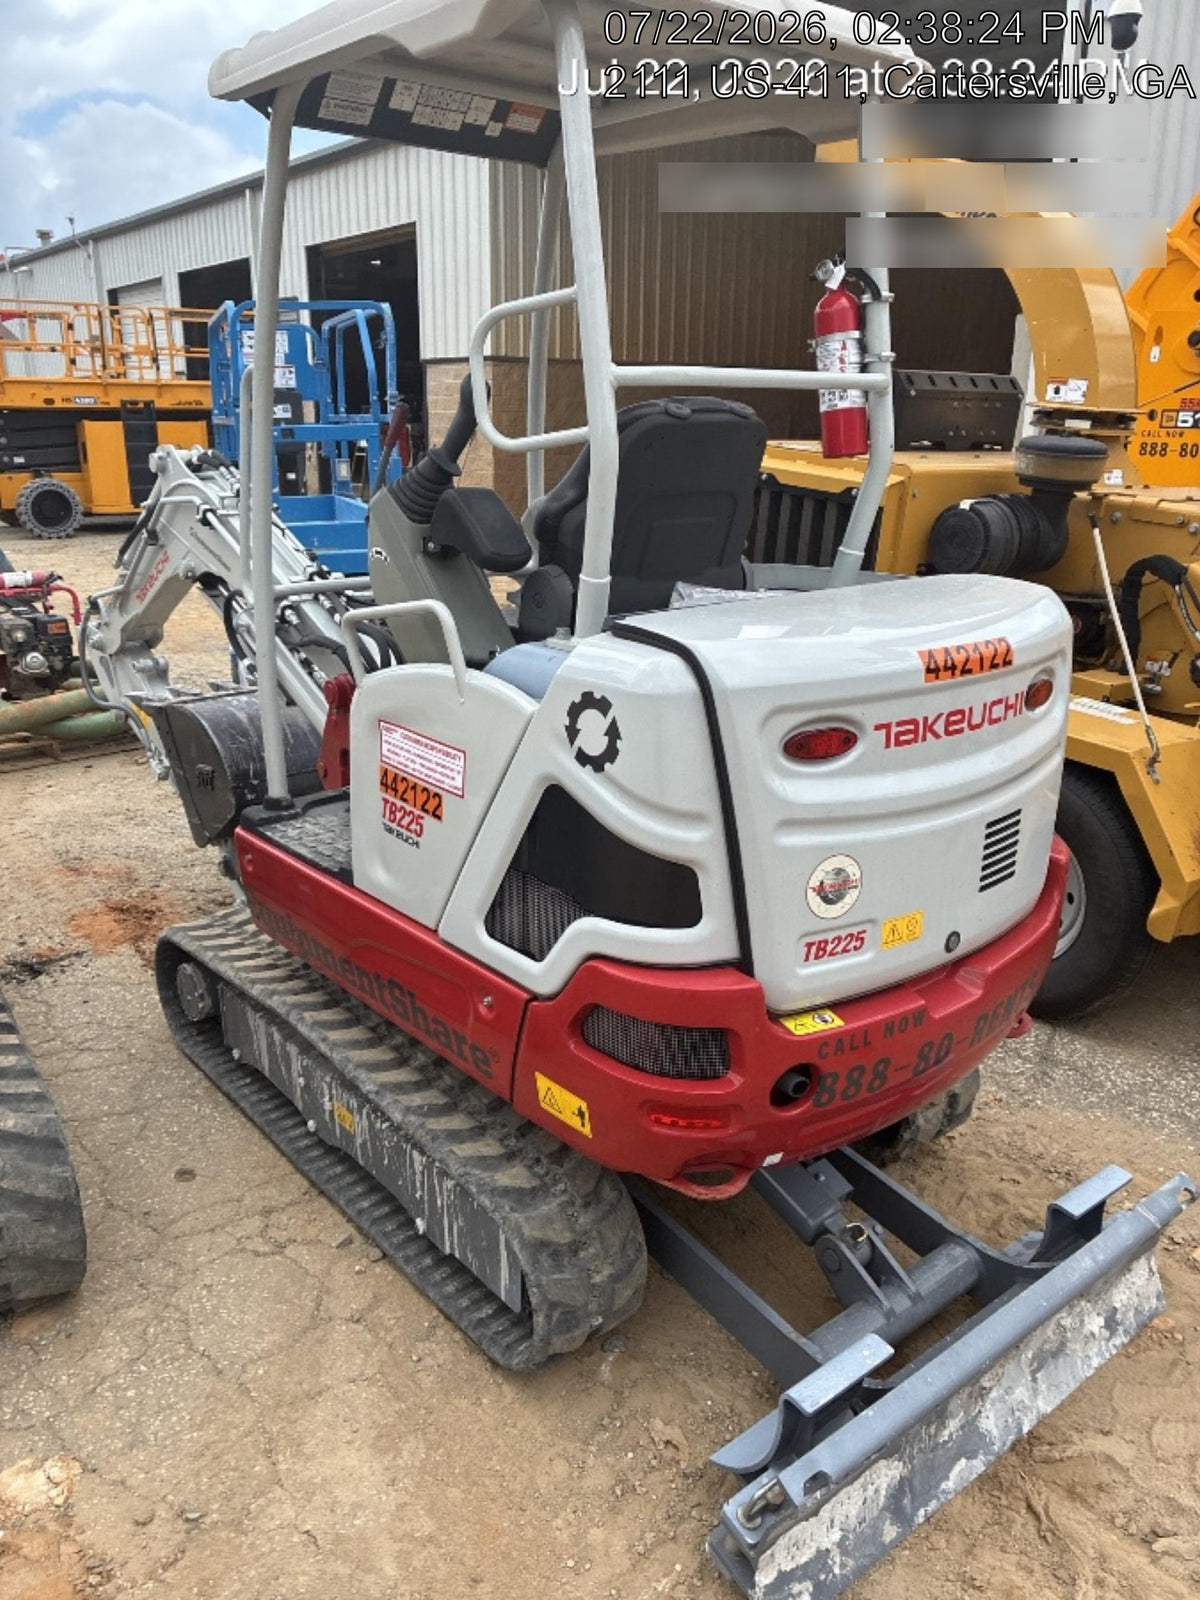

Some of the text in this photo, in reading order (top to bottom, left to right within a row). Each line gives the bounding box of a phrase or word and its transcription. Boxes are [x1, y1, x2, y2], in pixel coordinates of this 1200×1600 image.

[1141, 430, 1185, 438] CALL NOW
[925, 638, 1013, 680] 442122
[380, 767, 443, 822] 442122
[382, 796, 424, 838] TB225
[803, 929, 867, 963] TB225
[817, 1006, 926, 1060] CALL NOW
